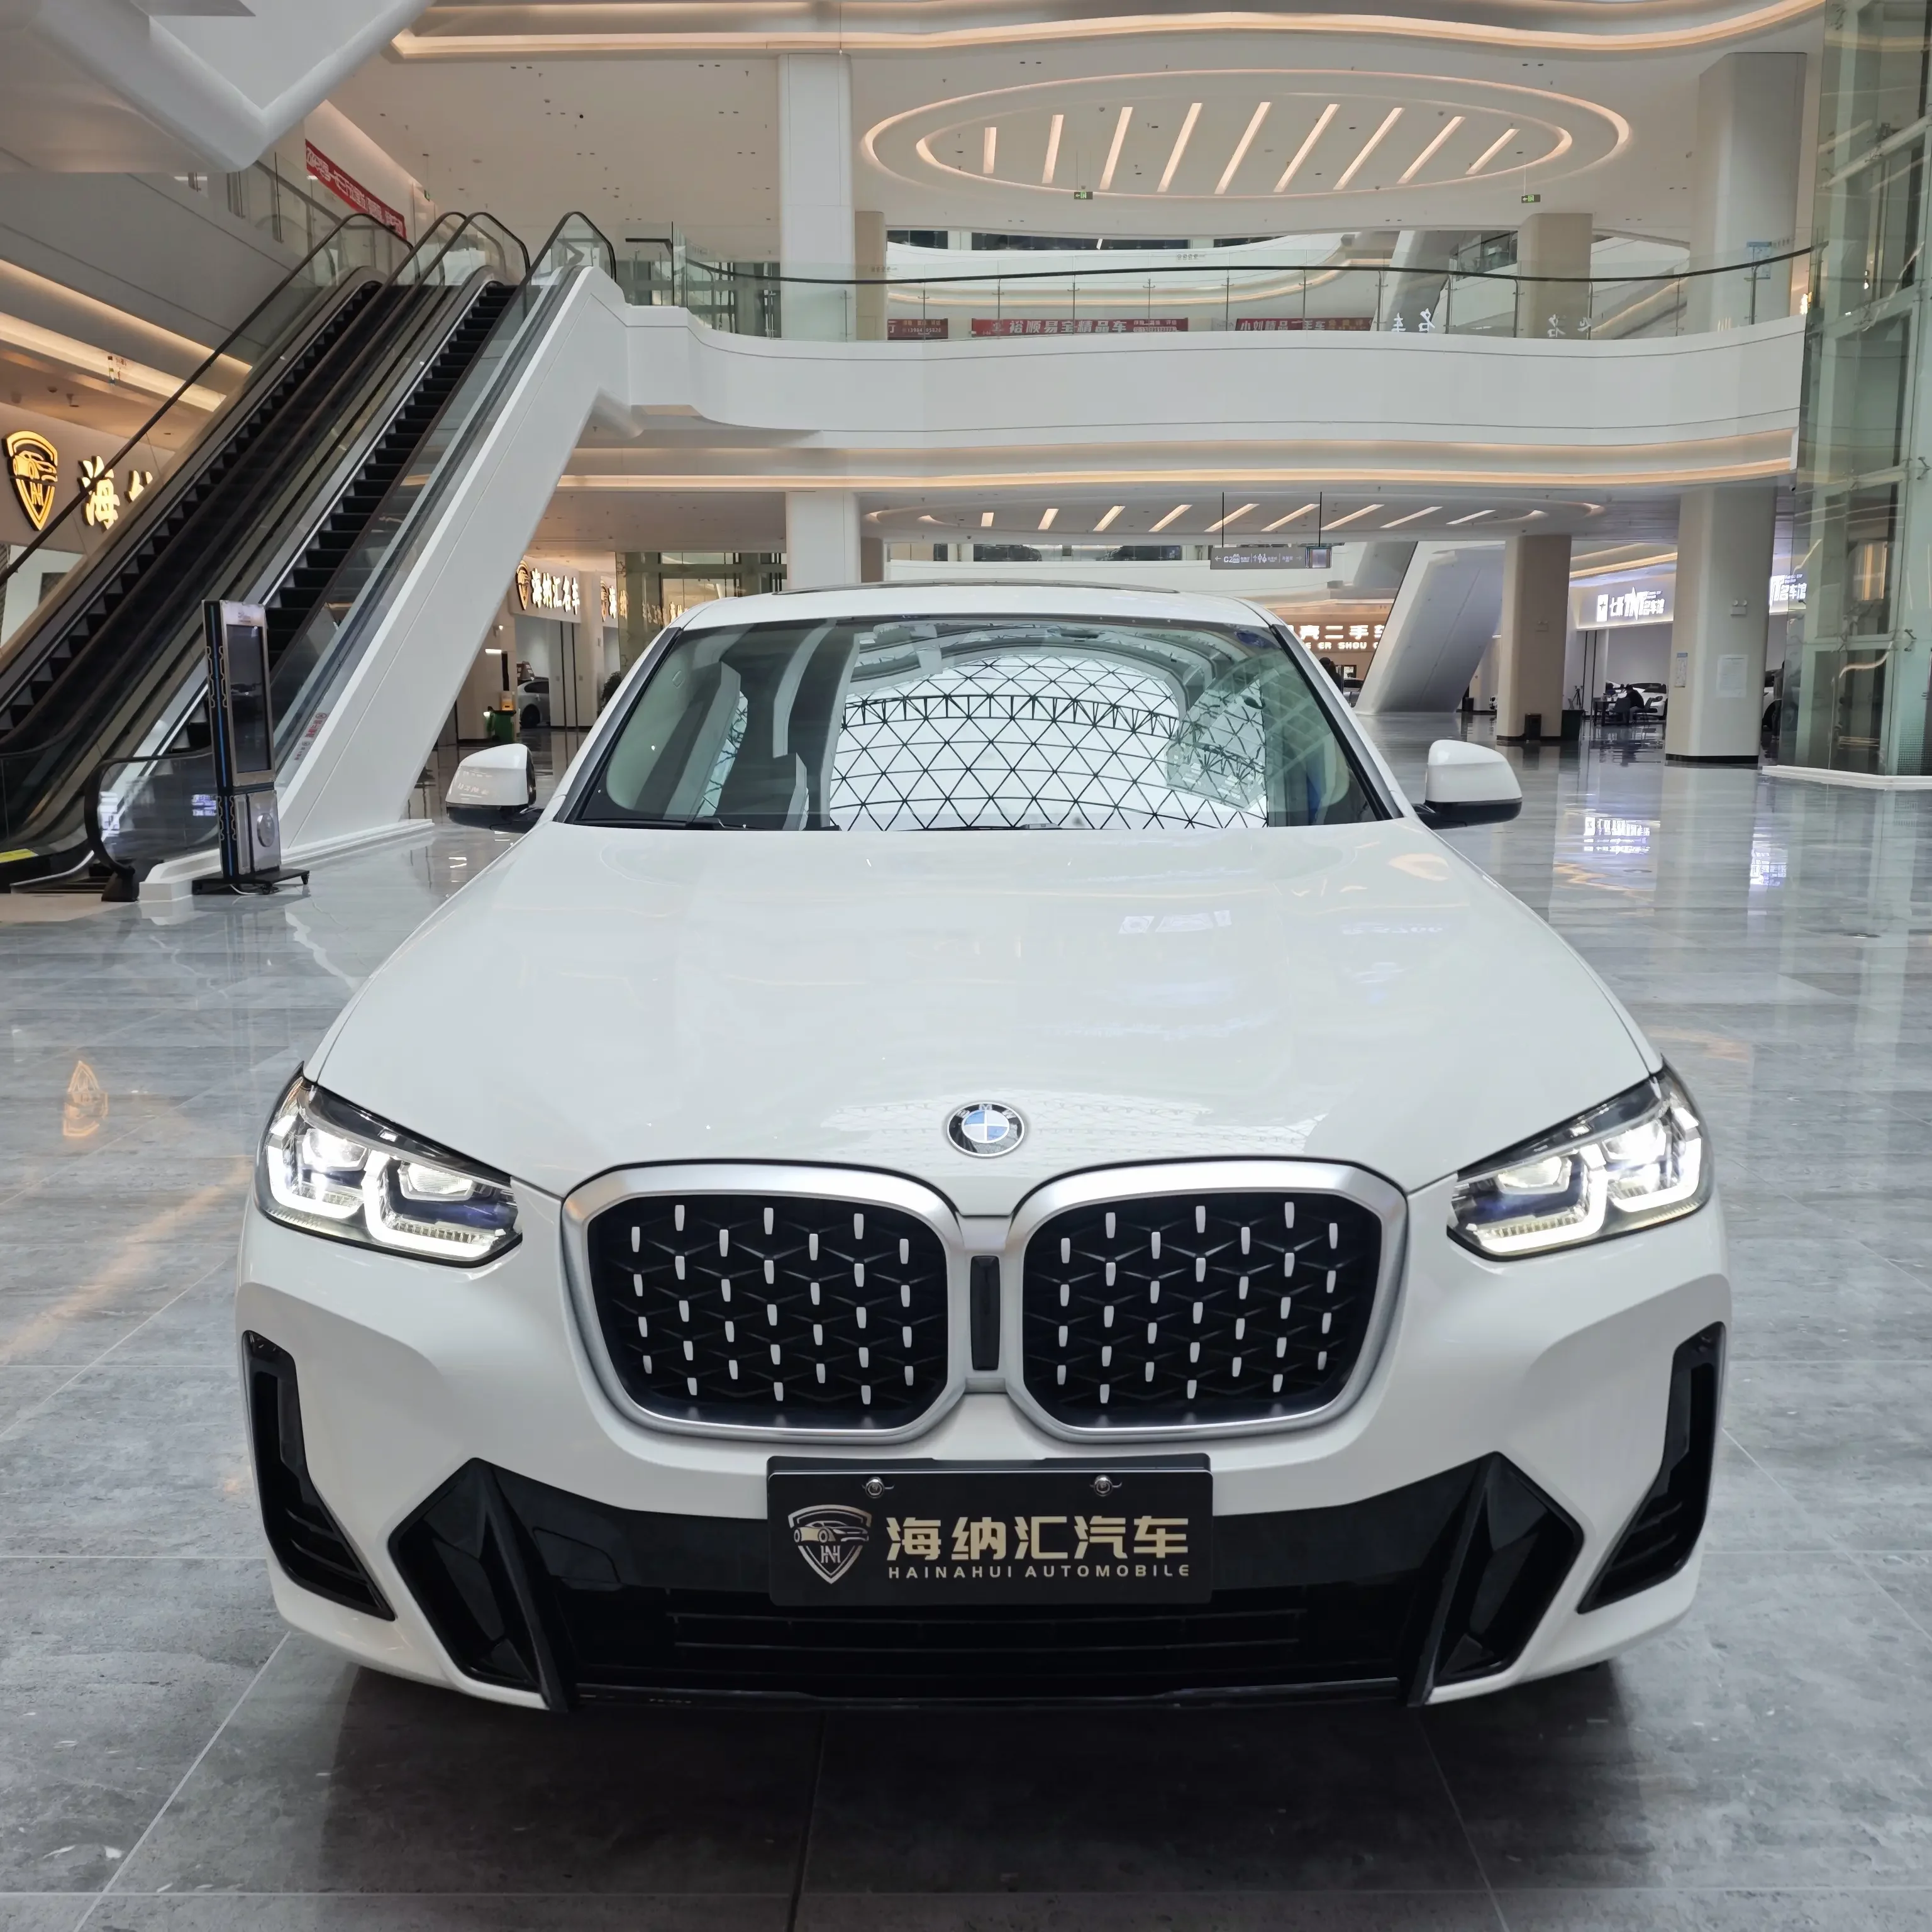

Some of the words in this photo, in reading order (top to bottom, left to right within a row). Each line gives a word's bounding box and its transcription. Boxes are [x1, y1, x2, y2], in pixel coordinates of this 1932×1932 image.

[1009, 319, 1127, 334] 裕顺易宝精品车
[1318, 641, 1332, 650] ER
[1338, 641, 1367, 650] SHOU
[886, 1516, 1189, 1562] 海纳汇汽车
[888, 1566, 1012, 1579] HAINAHUI
[1025, 1564, 1190, 1579] AUTOMOBILE
